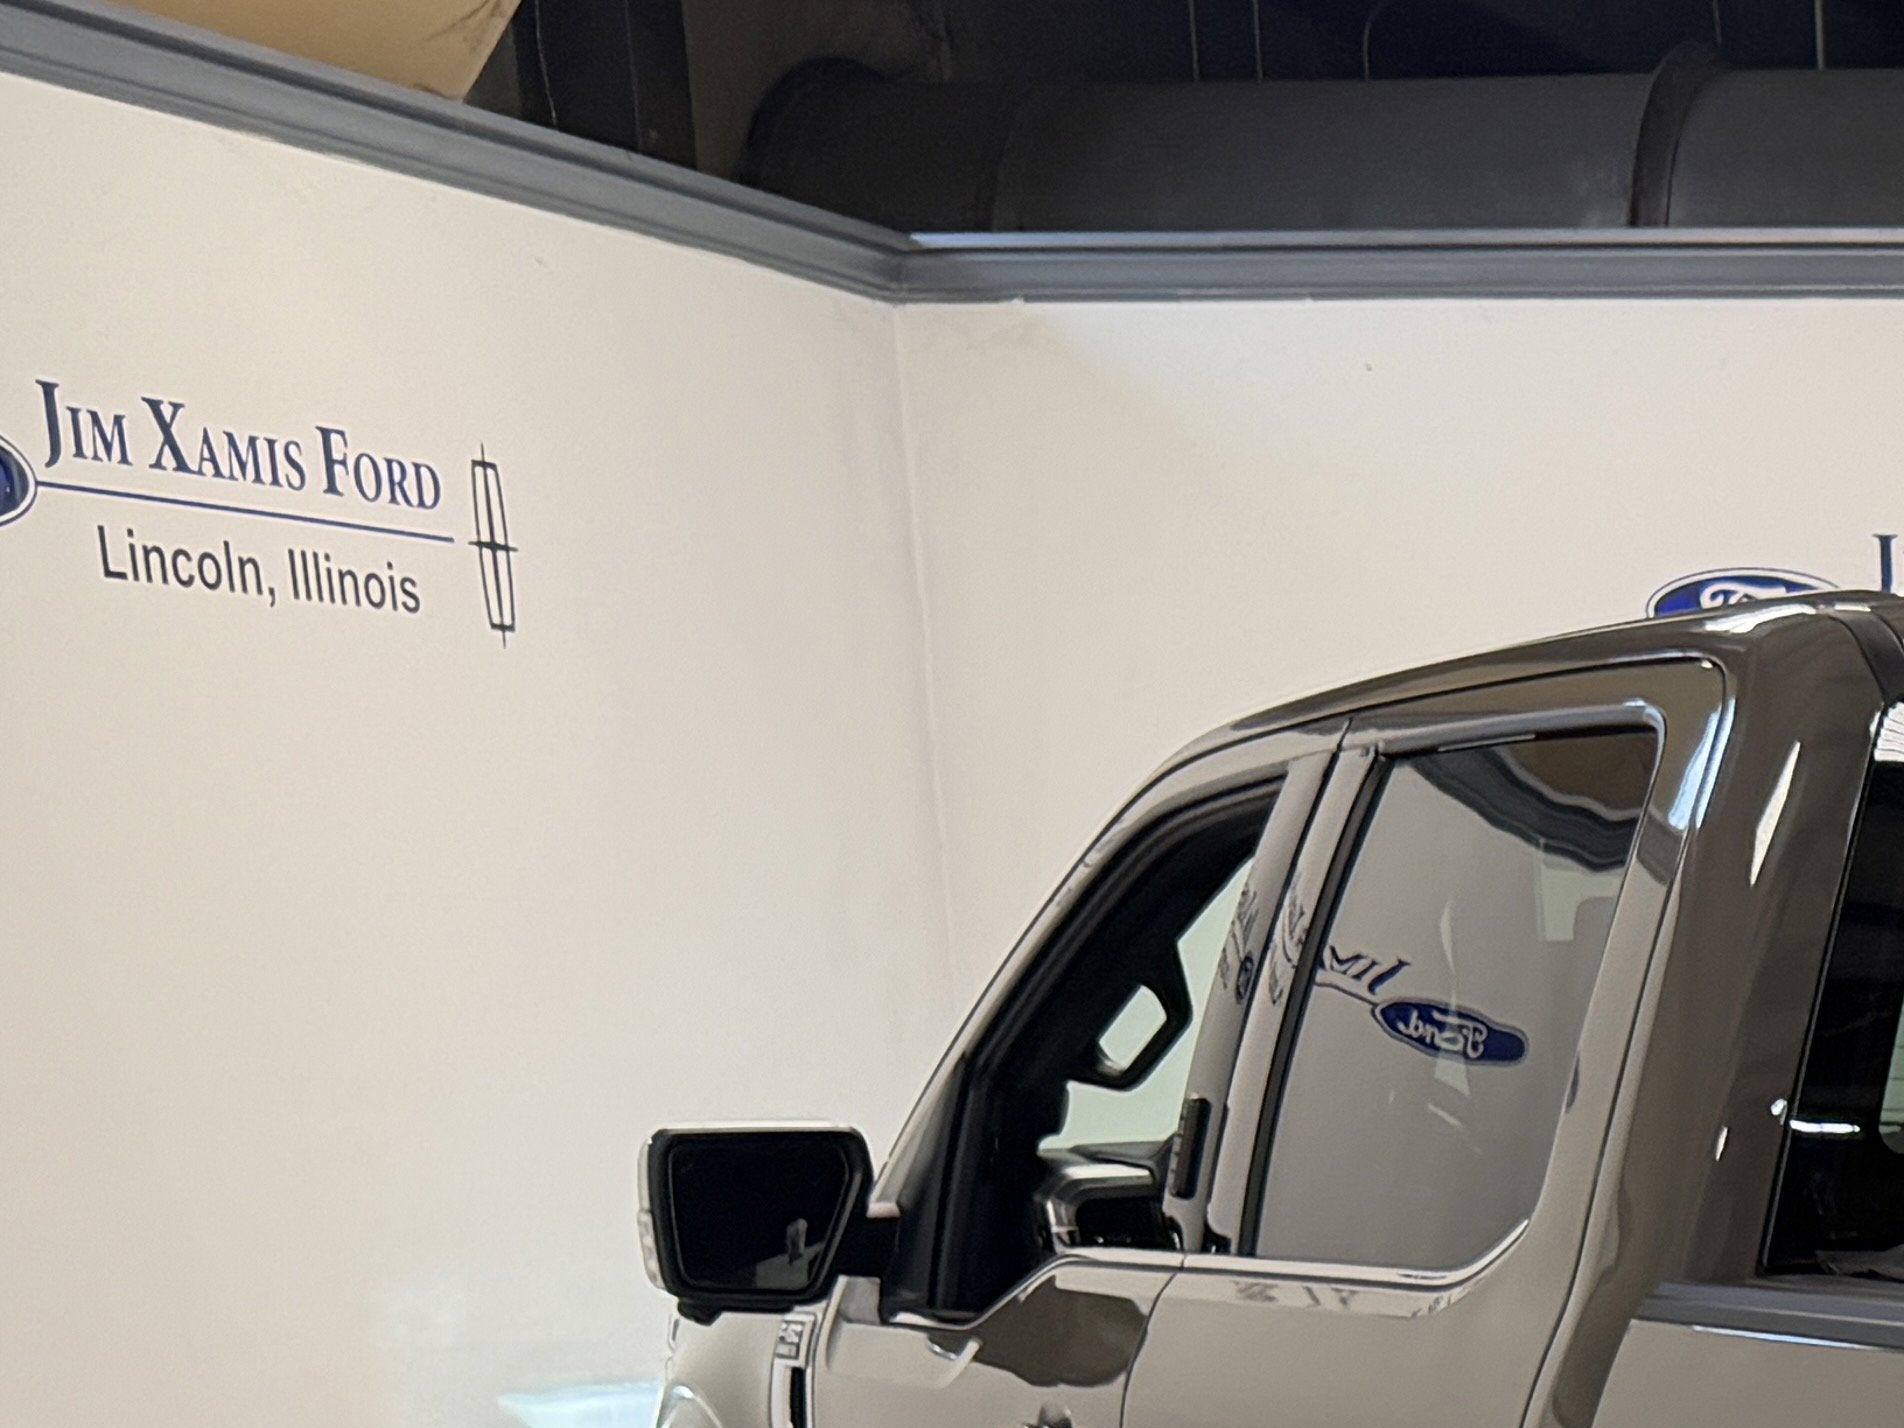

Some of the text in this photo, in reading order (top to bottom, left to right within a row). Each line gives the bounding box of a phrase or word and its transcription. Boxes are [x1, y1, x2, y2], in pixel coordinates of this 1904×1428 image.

[35, 378, 442, 510] JIM XAMIS FORD
[97, 524, 421, 614] Lincoln, Illinois
